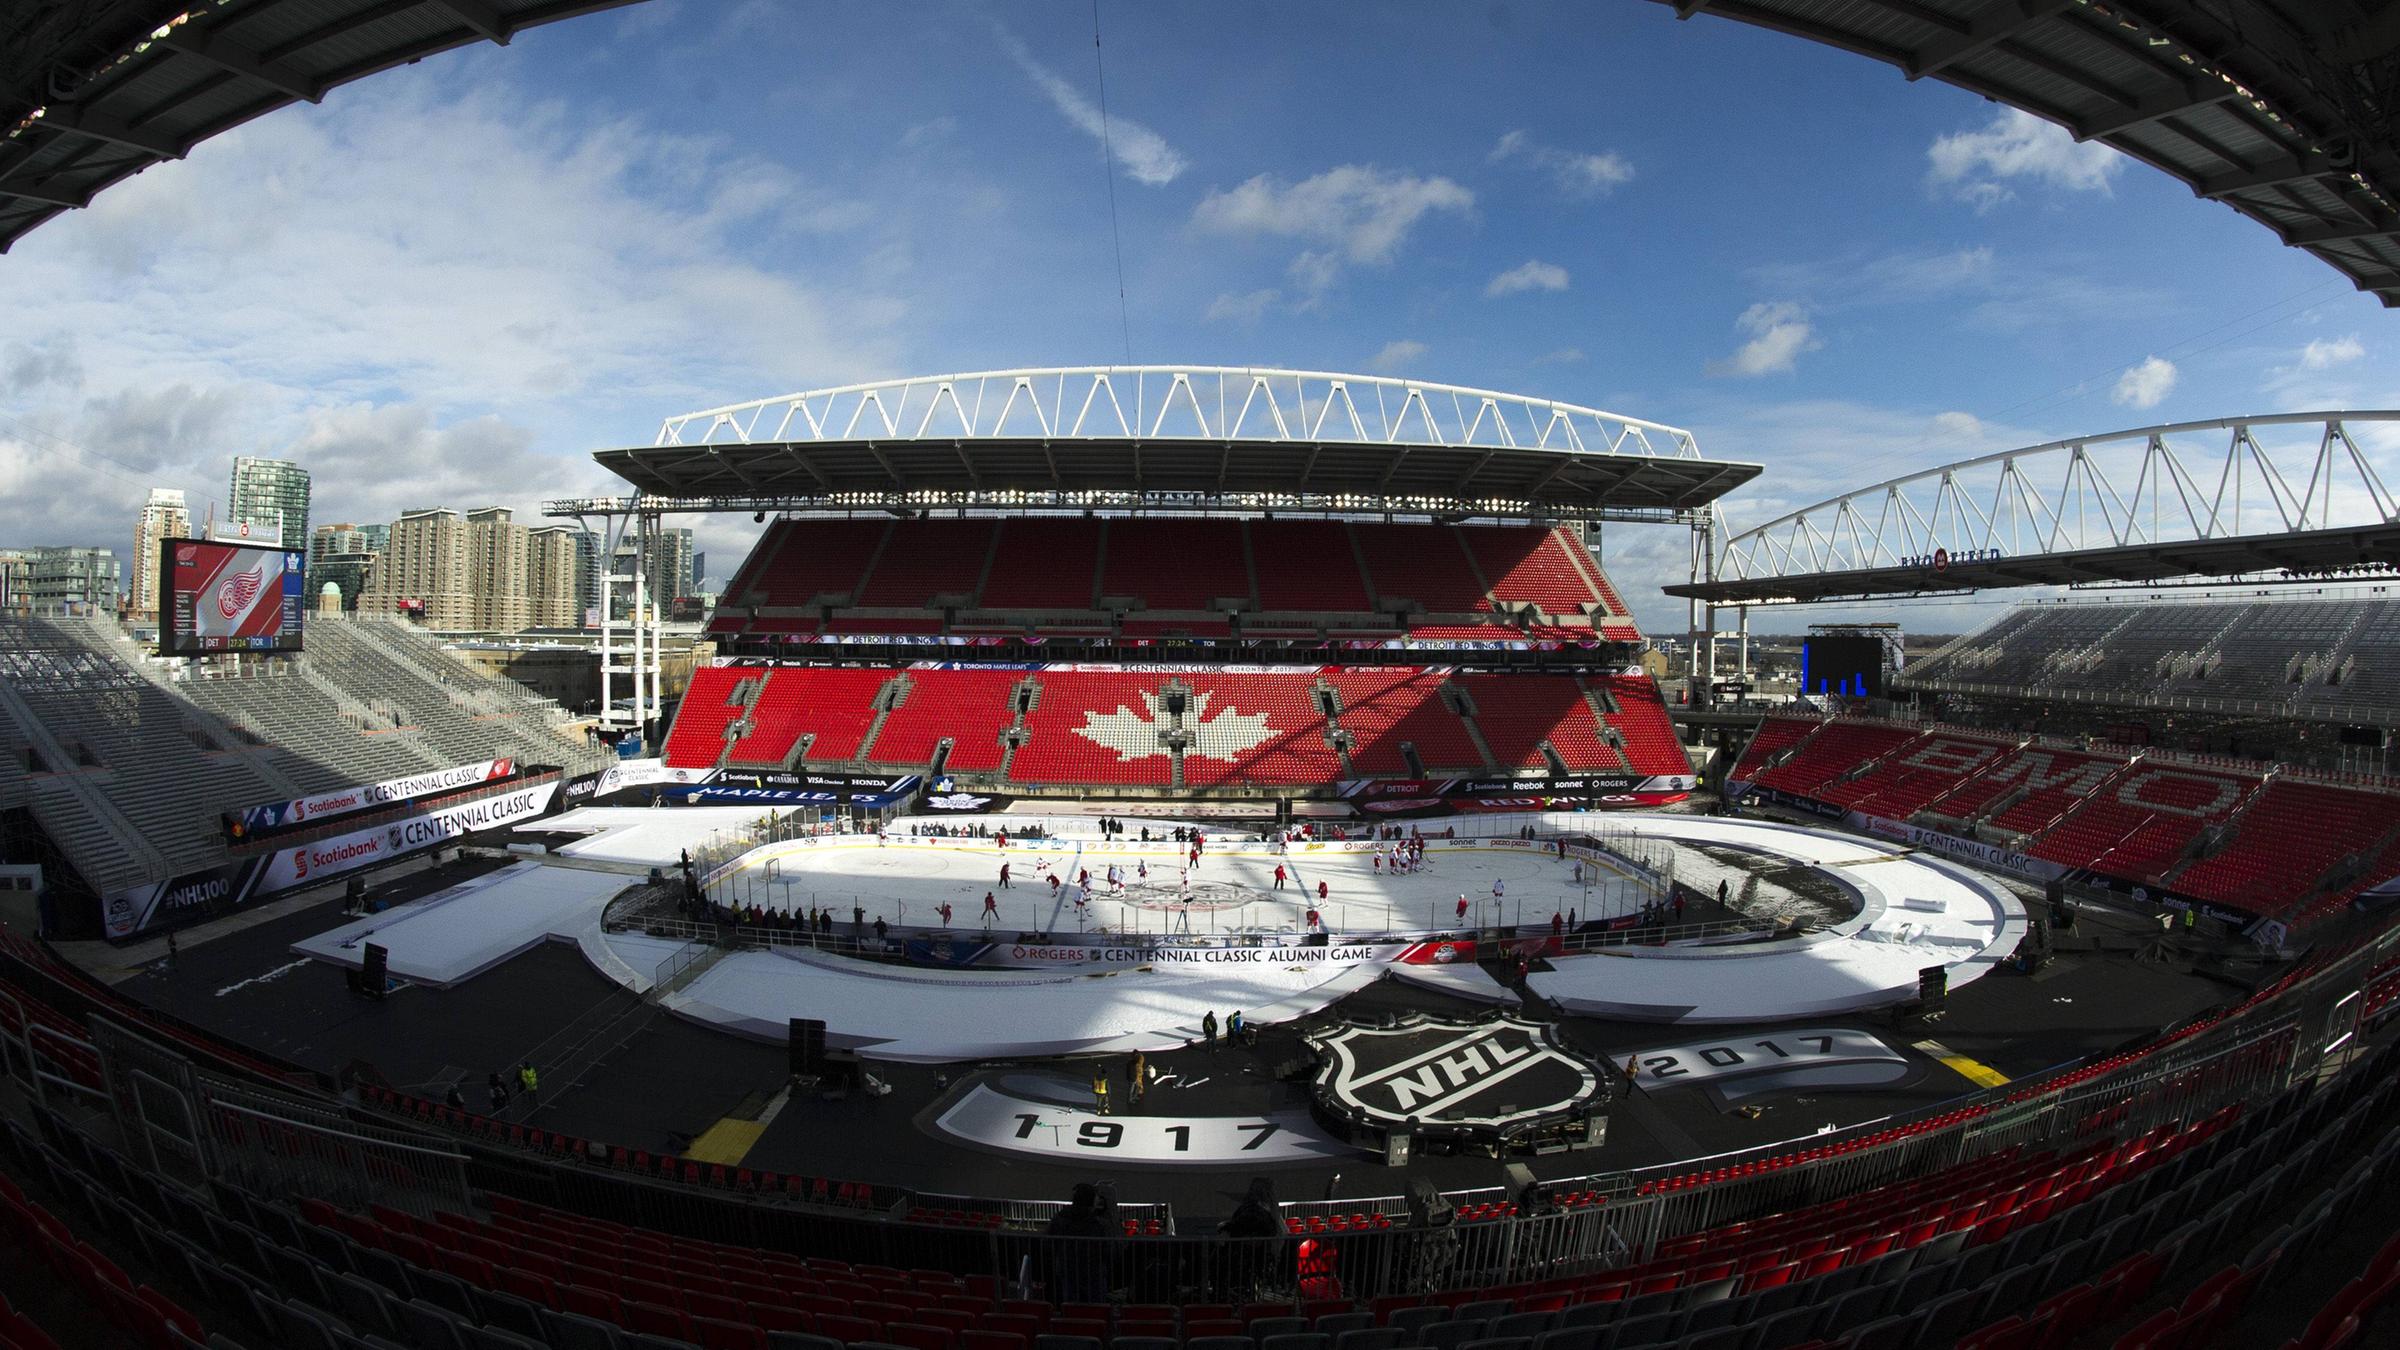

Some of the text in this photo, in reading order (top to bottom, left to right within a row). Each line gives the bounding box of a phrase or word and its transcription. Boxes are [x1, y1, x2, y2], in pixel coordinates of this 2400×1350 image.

[1901, 548, 2001, 569] BMO FIELD
[207, 637, 220, 647] DET
[230, 637, 247, 648] 27:24
[252, 637, 264, 647] TOR
[853, 636, 933, 645] DETROIT RED WINGS
[1418, 641, 1498, 650] DETROIT RED WINGS
[1129, 663, 1225, 674] CENTENNIAL CLASSIC
[806, 776, 824, 784] VISA
[851, 779, 888, 787] HONDA
[1900, 738, 2241, 818] BMO
[308, 766, 481, 814] Scotiabank CENTENNIAL CLASSIC
[566, 779, 596, 797] #NHL100
[1386, 784, 1420, 793] DETROIT
[1513, 782, 1545, 790] Reebok
[1554, 780, 1584, 789] sonnet
[700, 787, 792, 799] MAPLE
[1479, 798, 1536, 806] RED
[312, 793, 535, 868] Scotiabank CENTENNIAL CLASSIC
[1353, 842, 1385, 850] ROGERS
[1490, 839, 1531, 849] pizza pizza
[1874, 819, 2031, 872] Scotiabank CENTENNIAL CLASSIC
[165, 878, 230, 909] #NHL100
[1029, 947, 1373, 963] ROGERS CENTENNIAL CLASSIC ALUMNI GAME
[1643, 1035, 1834, 1079] 2017
[1384, 1037, 1530, 1111] NHL
[1014, 1113, 1281, 1152] 1917
